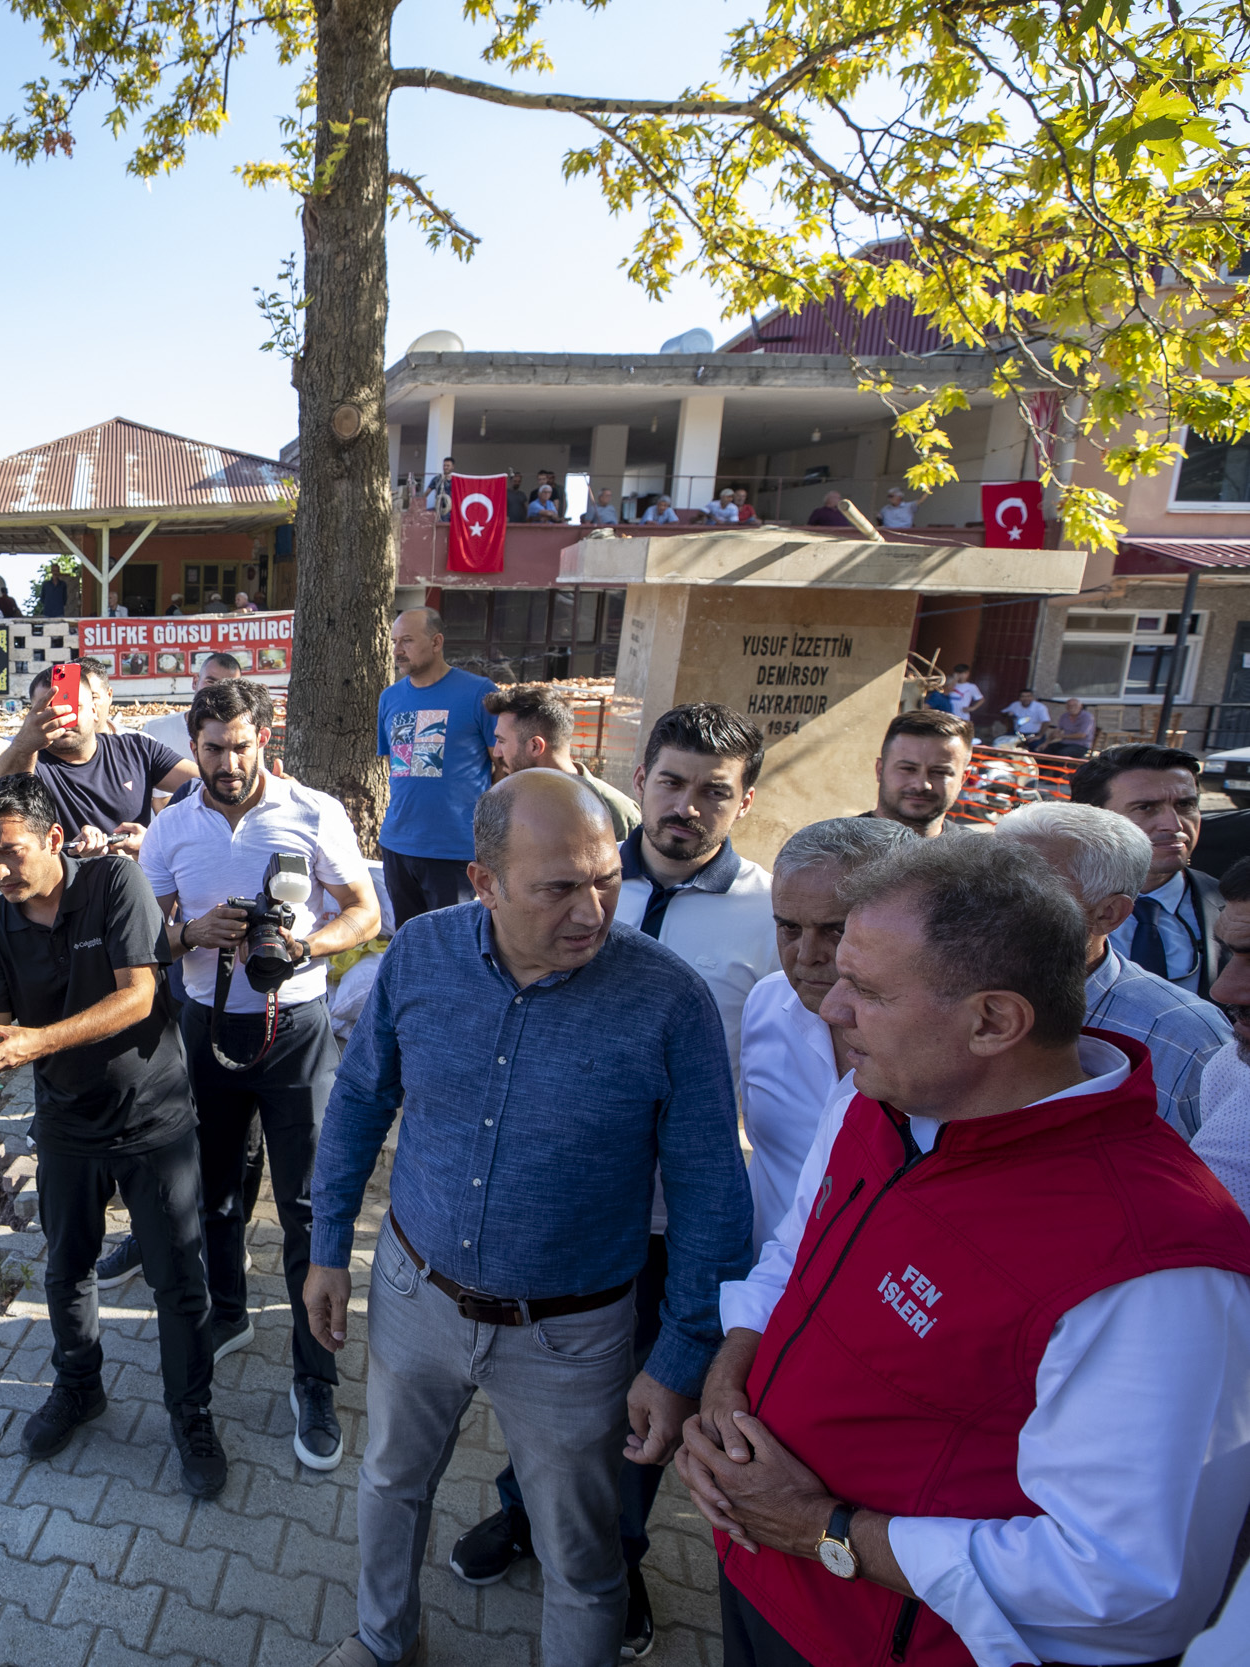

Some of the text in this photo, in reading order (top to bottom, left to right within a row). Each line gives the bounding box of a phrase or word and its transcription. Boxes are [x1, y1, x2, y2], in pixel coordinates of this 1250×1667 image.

[84, 622, 148, 646] SİLİFKE
[153, 621, 212, 645] GÖKSU
[742, 632, 854, 658] YUSUF İZZETTİN
[756, 662, 829, 686] DEMİRSOY
[747, 694, 828, 714] HAYRATIDIR
[768, 720, 800, 735] 1954
[901, 1264, 943, 1308] FEN
[877, 1271, 938, 1339] İŞLERİ
